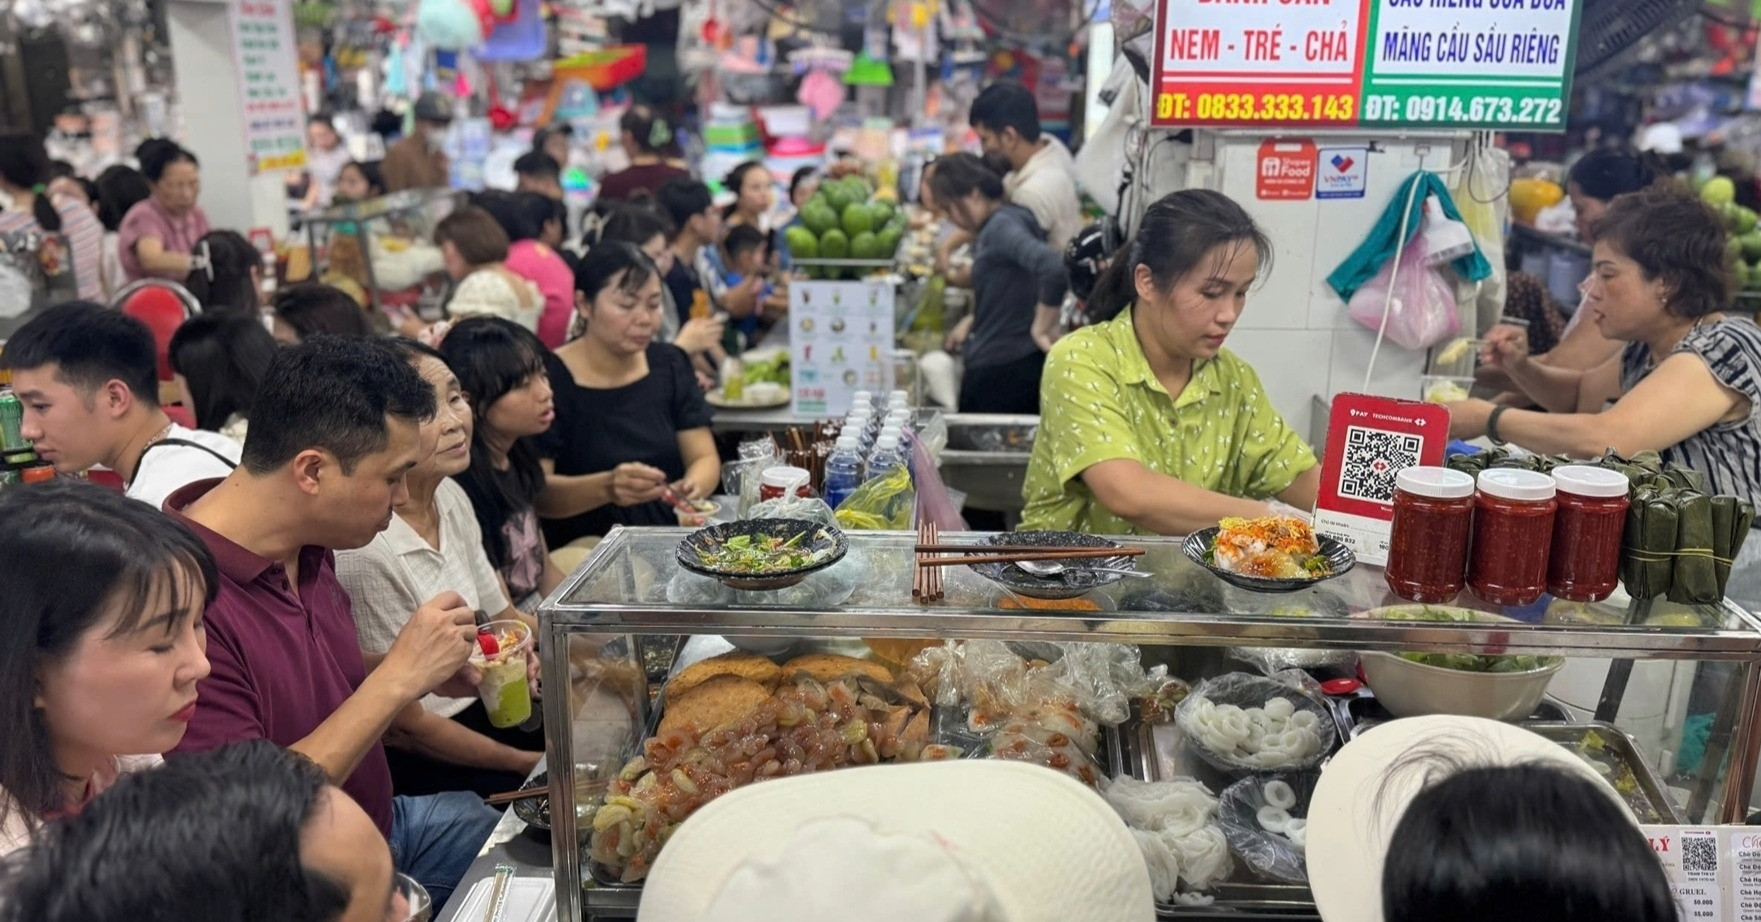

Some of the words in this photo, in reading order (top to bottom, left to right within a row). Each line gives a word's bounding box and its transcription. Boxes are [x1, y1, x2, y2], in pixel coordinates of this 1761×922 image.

[1170, 29, 1220, 60] NEM
[1244, 23, 1282, 61] TRÉ
[1305, 20, 1348, 61] CHẢ
[1383, 25, 1432, 62] MÃNG
[1436, 21, 1469, 62] CẦU
[1473, 22, 1507, 63] SẦU
[1510, 27, 1560, 64] RIÊNG
[1157, 93, 1191, 119] ĐT:
[1197, 93, 1353, 120] 0833.333.143
[1365, 95, 1400, 121] ĐT:
[1405, 95, 1562, 123] 0914.673.272
[1281, 165, 1310, 176] Food
[1372, 413, 1413, 424] TECHCOMBANK
